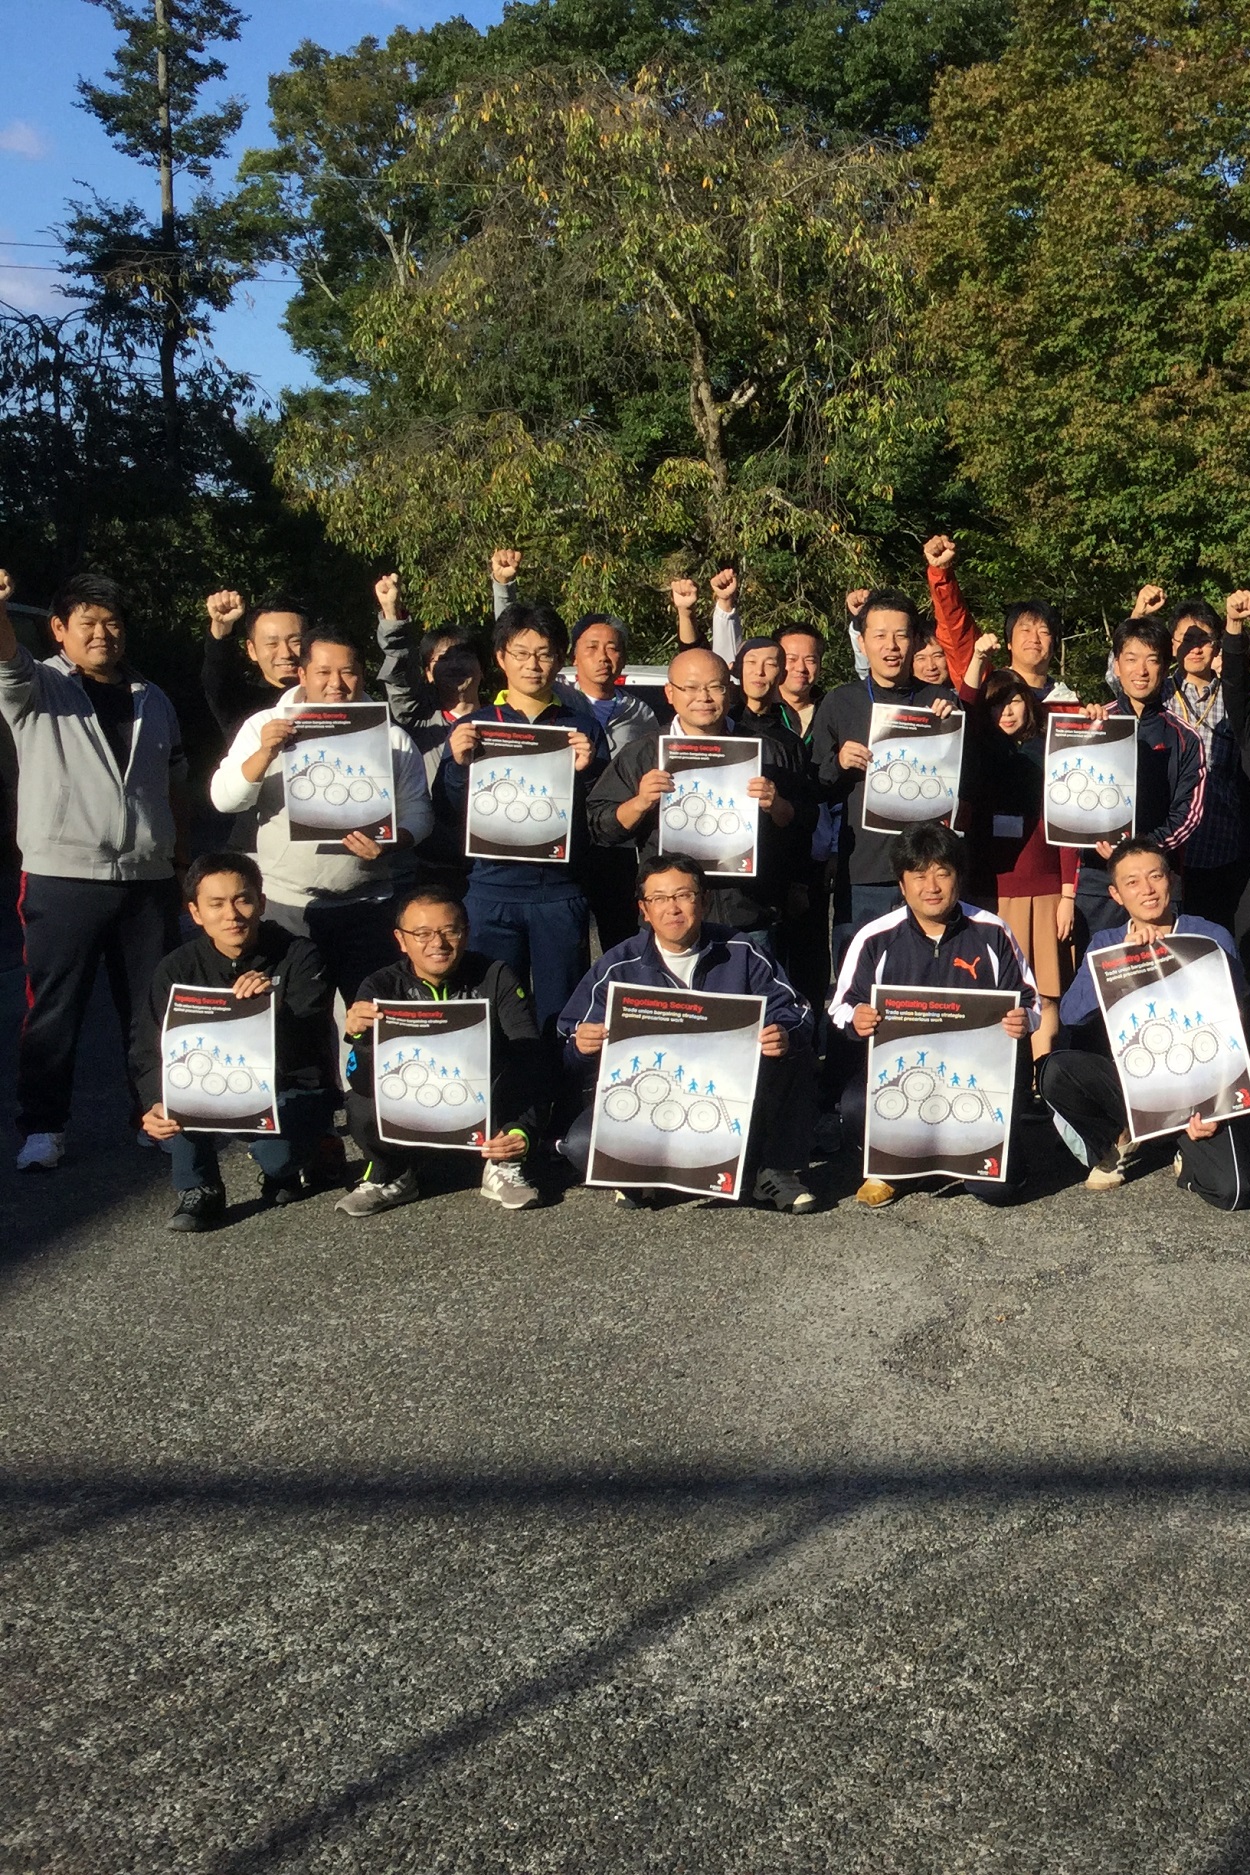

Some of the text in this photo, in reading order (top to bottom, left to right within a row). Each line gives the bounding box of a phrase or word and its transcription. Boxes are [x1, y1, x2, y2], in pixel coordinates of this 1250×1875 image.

[622, 997, 703, 1013] Negotiating Security
[885, 999, 961, 1011] Negotiating Security
